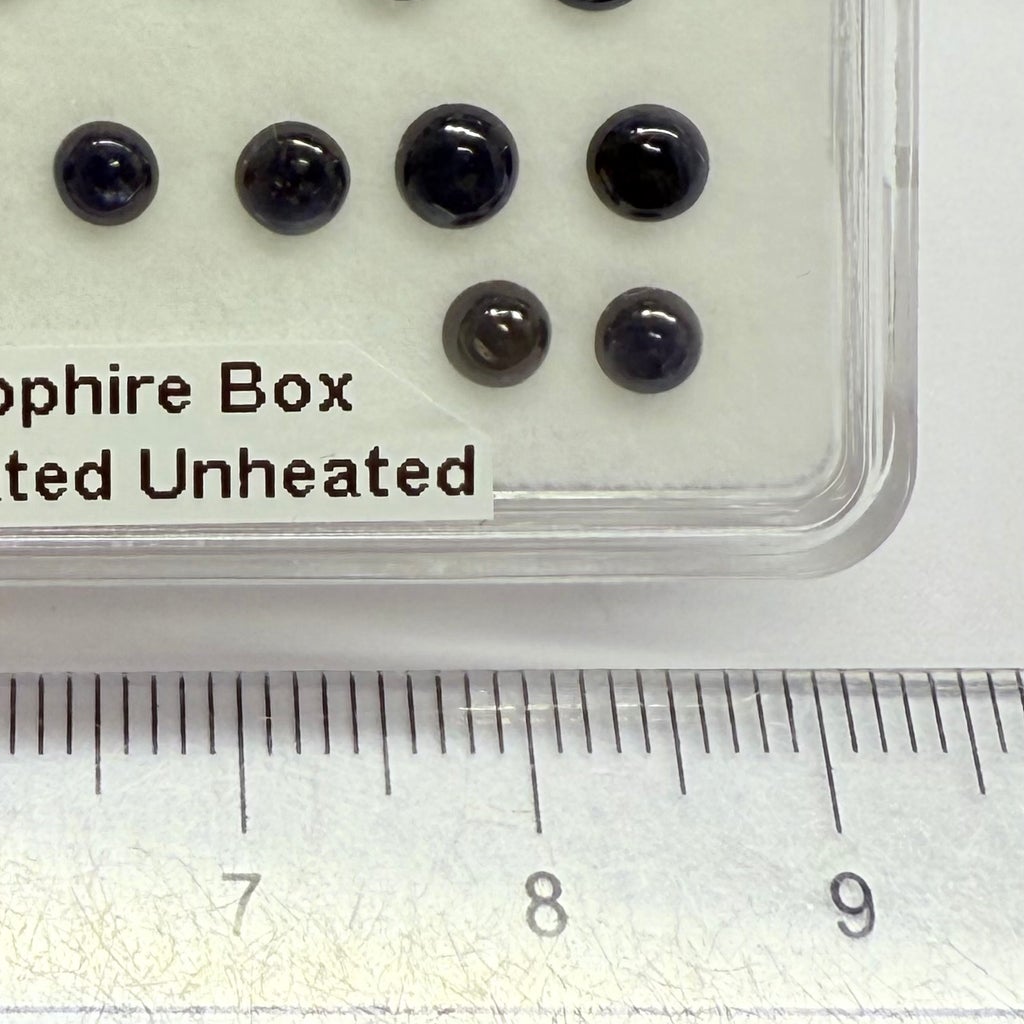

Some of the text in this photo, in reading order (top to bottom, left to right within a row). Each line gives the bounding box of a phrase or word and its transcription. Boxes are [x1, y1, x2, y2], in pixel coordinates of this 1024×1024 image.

[220, 361, 353, 414] Box
[140, 444, 475, 500] Unheated
[222, 872, 262, 937] 7
[525, 871, 568, 938] 8
[830, 871, 875, 939] 9
